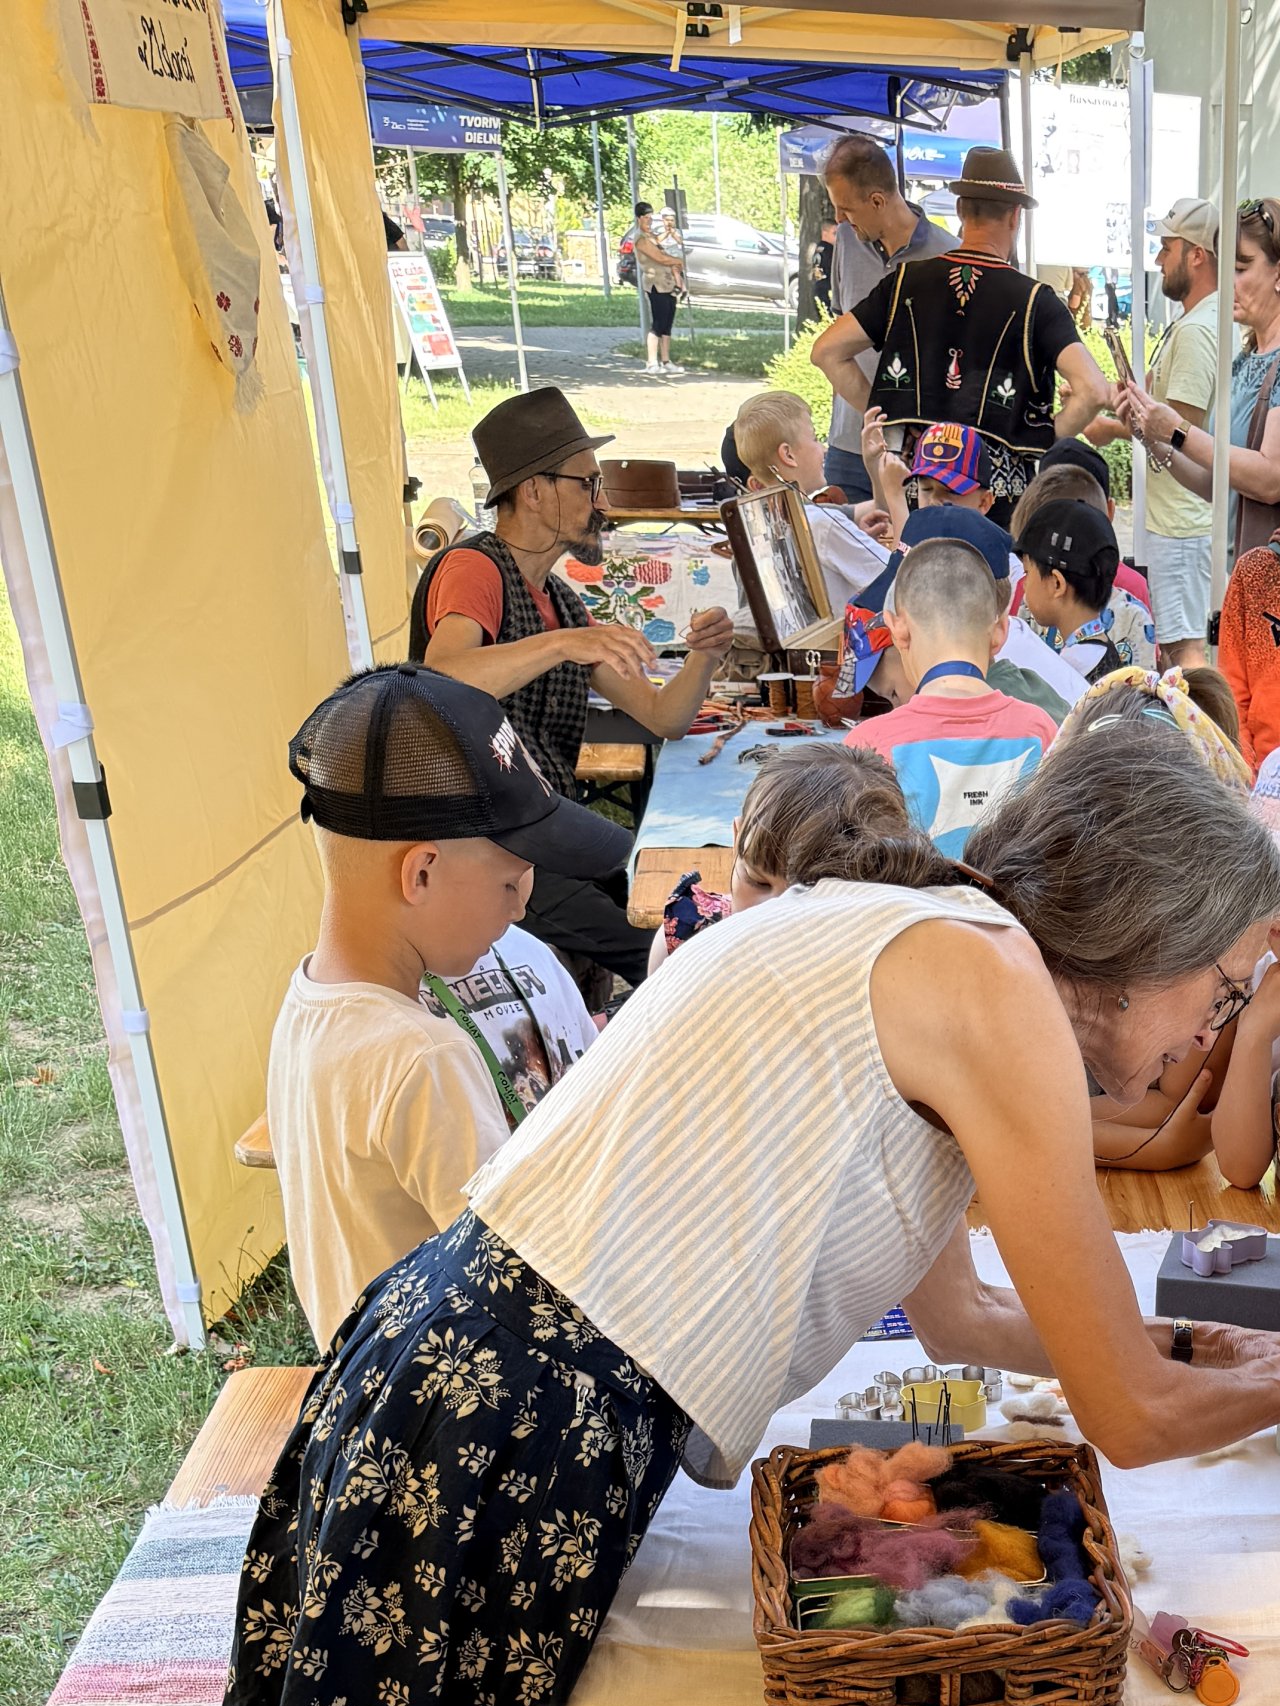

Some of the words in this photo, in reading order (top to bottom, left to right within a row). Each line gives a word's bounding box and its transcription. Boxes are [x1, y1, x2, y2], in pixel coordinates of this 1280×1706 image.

[459, 115, 502, 130] TVORIV
[963, 790, 989, 799] FRESH
[484, 1003, 523, 1020] MOVIE
